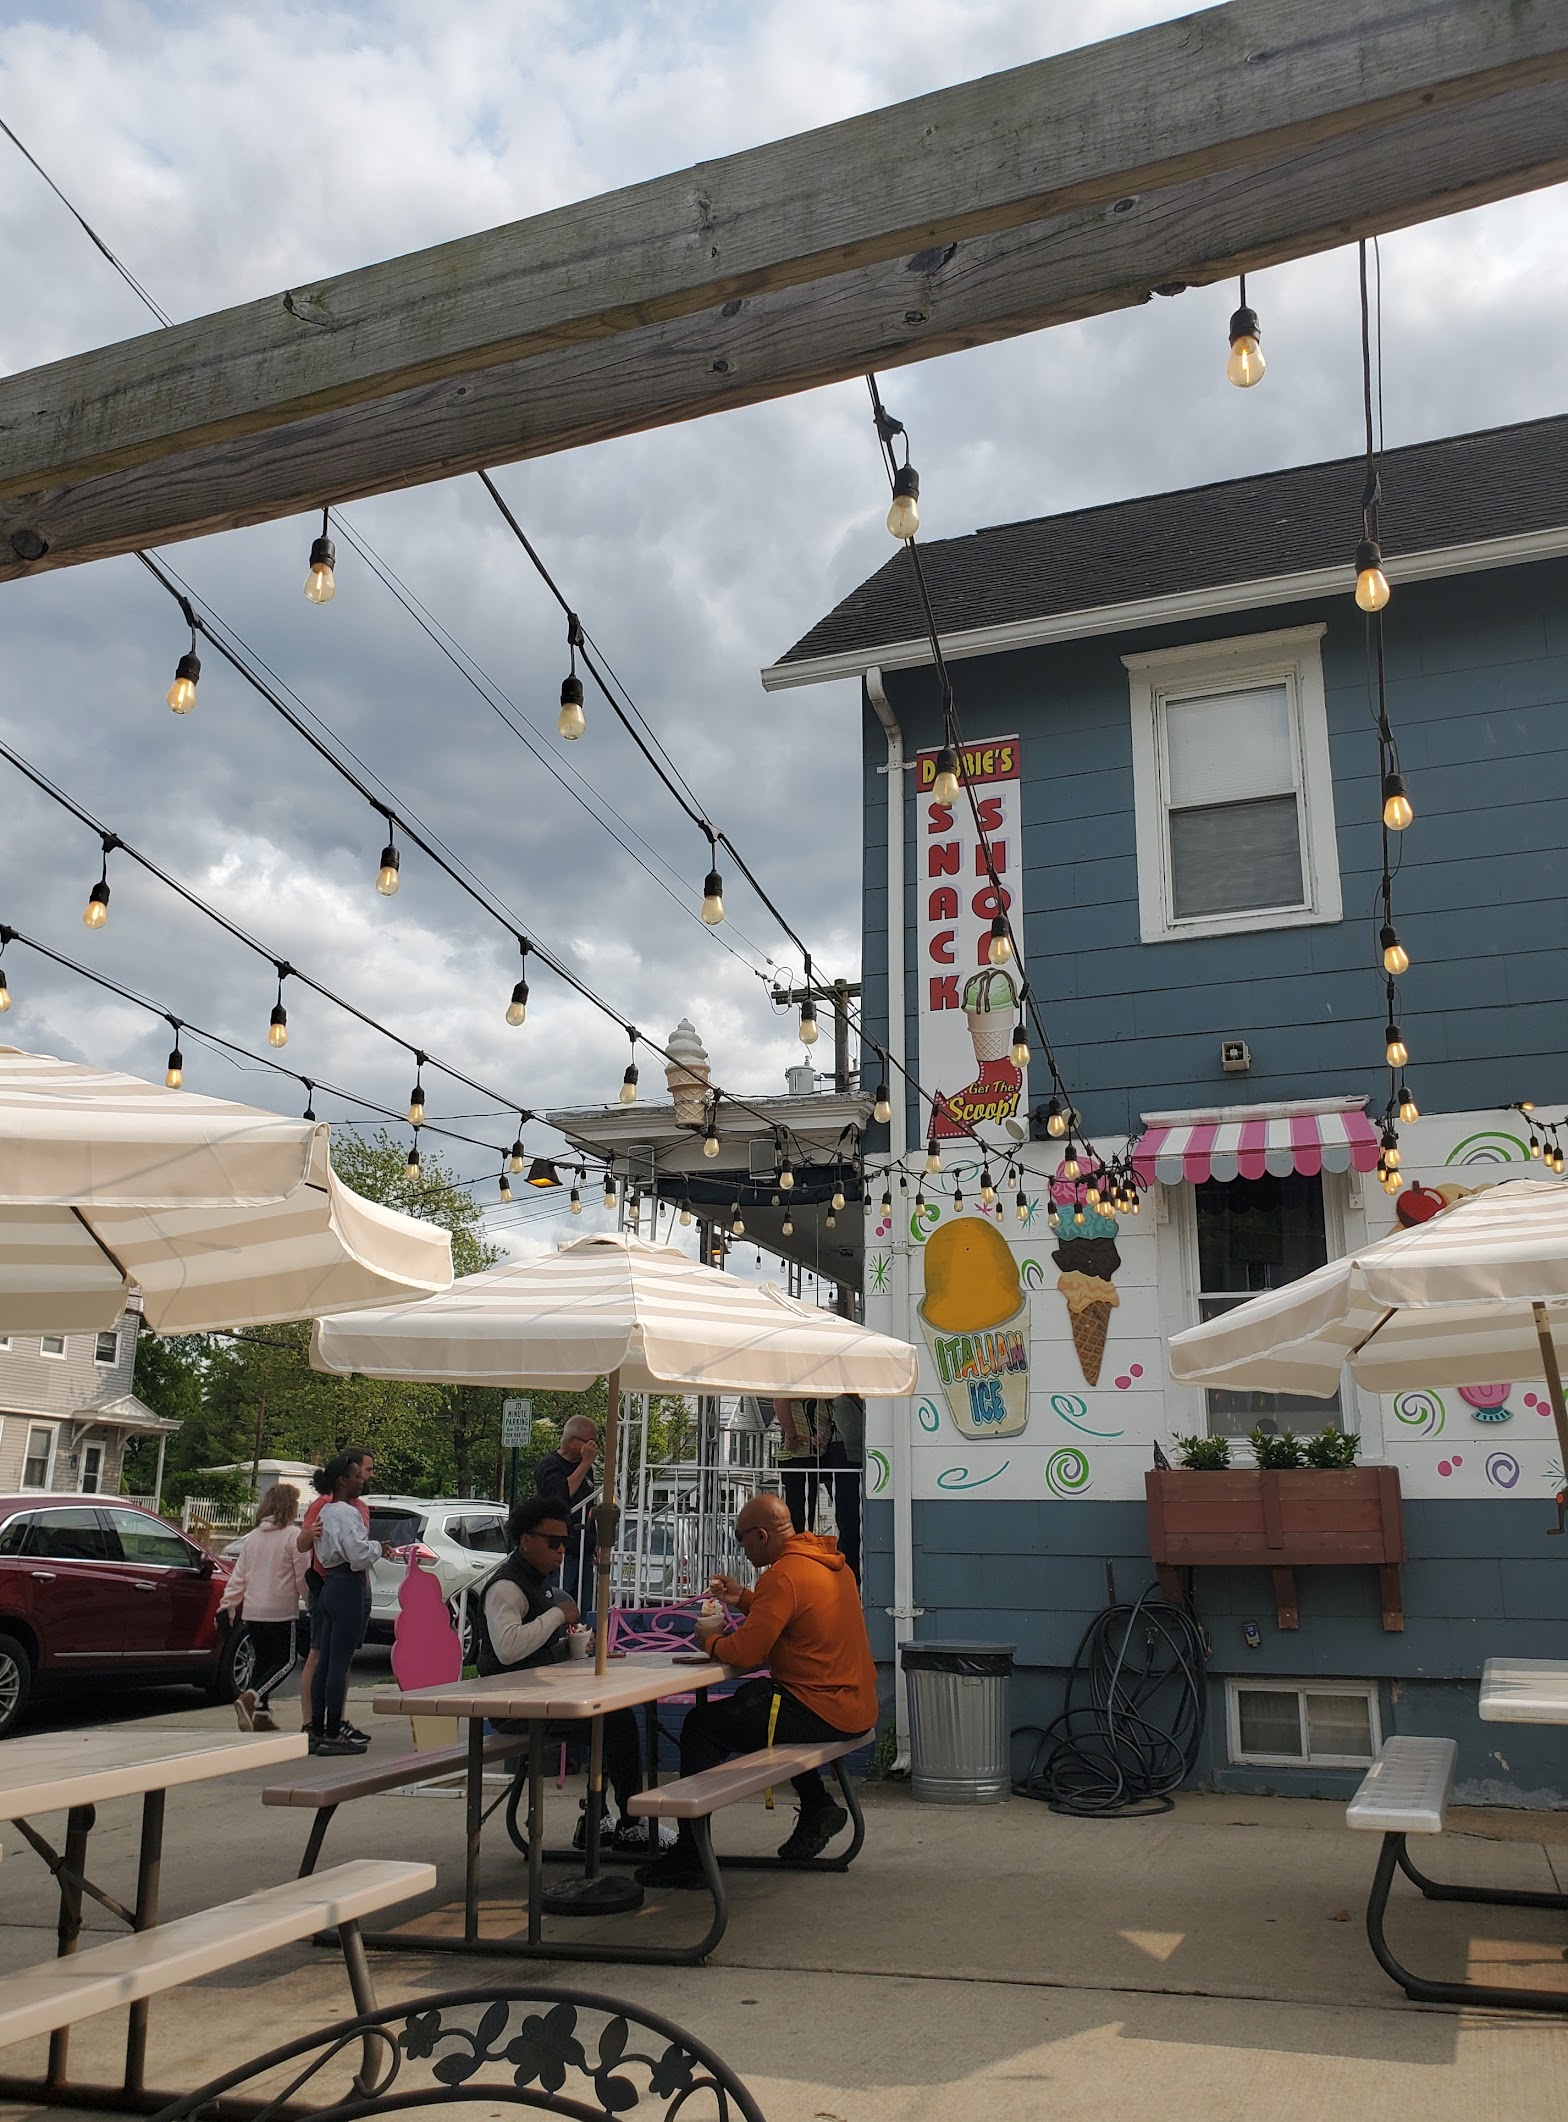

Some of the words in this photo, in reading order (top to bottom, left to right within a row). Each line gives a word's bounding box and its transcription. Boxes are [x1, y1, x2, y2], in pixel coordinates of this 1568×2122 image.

[922, 747, 1013, 784] DBIE'S
[928, 801, 960, 1011] SNACK
[969, 1082, 990, 1095] Get
[993, 1080, 1015, 1093] The
[949, 1093, 1020, 1125] Scoop!
[935, 1331, 1027, 1384] ITALIAN
[507, 1410, 527, 1418] MINUTE
[514, 1402, 522, 1410] 30
[968, 1379, 1006, 1424] ICE
[505, 1418, 529, 1426] PARKING
